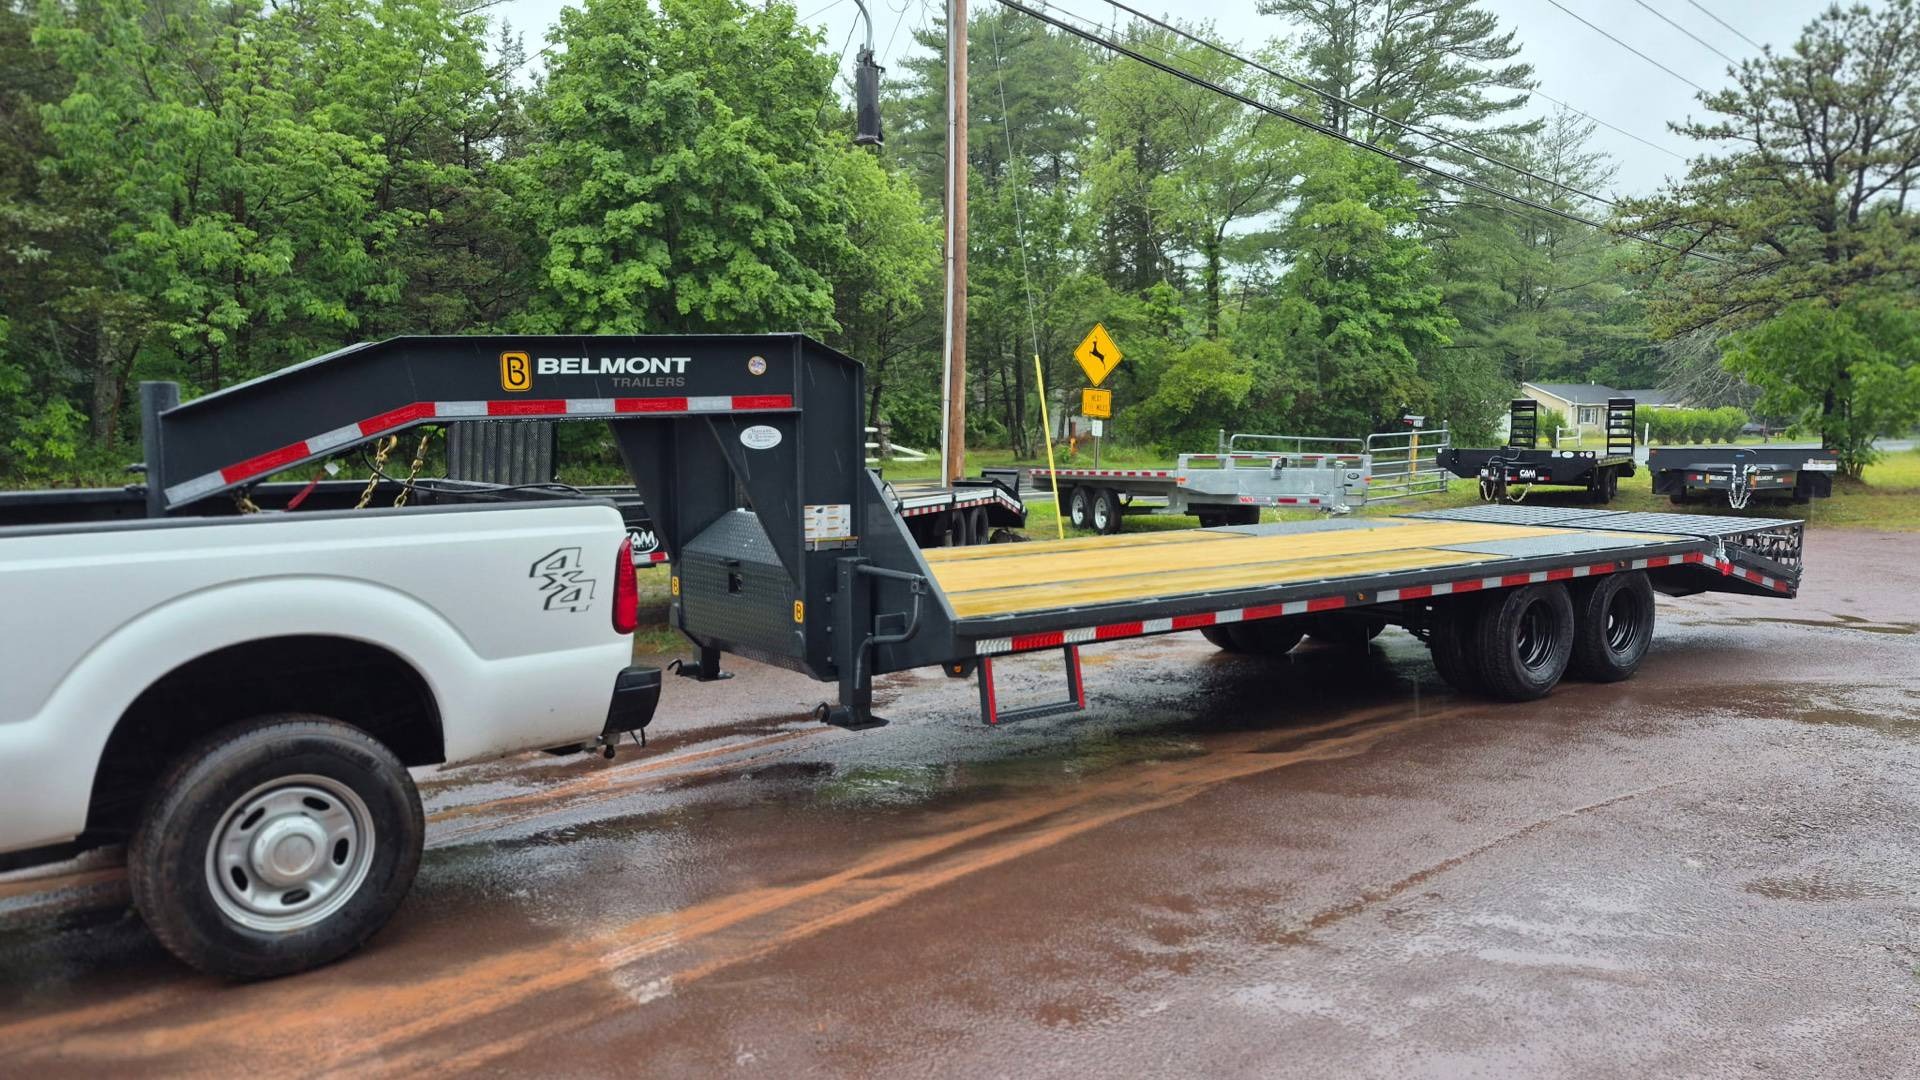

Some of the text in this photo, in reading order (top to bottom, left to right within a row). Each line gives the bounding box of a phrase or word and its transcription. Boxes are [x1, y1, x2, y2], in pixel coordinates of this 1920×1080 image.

[537, 357, 692, 375] BELMONT
[612, 376, 687, 389] TRAILERS
[1519, 469, 1536, 478] CAM
[626, 530, 656, 546] AM
